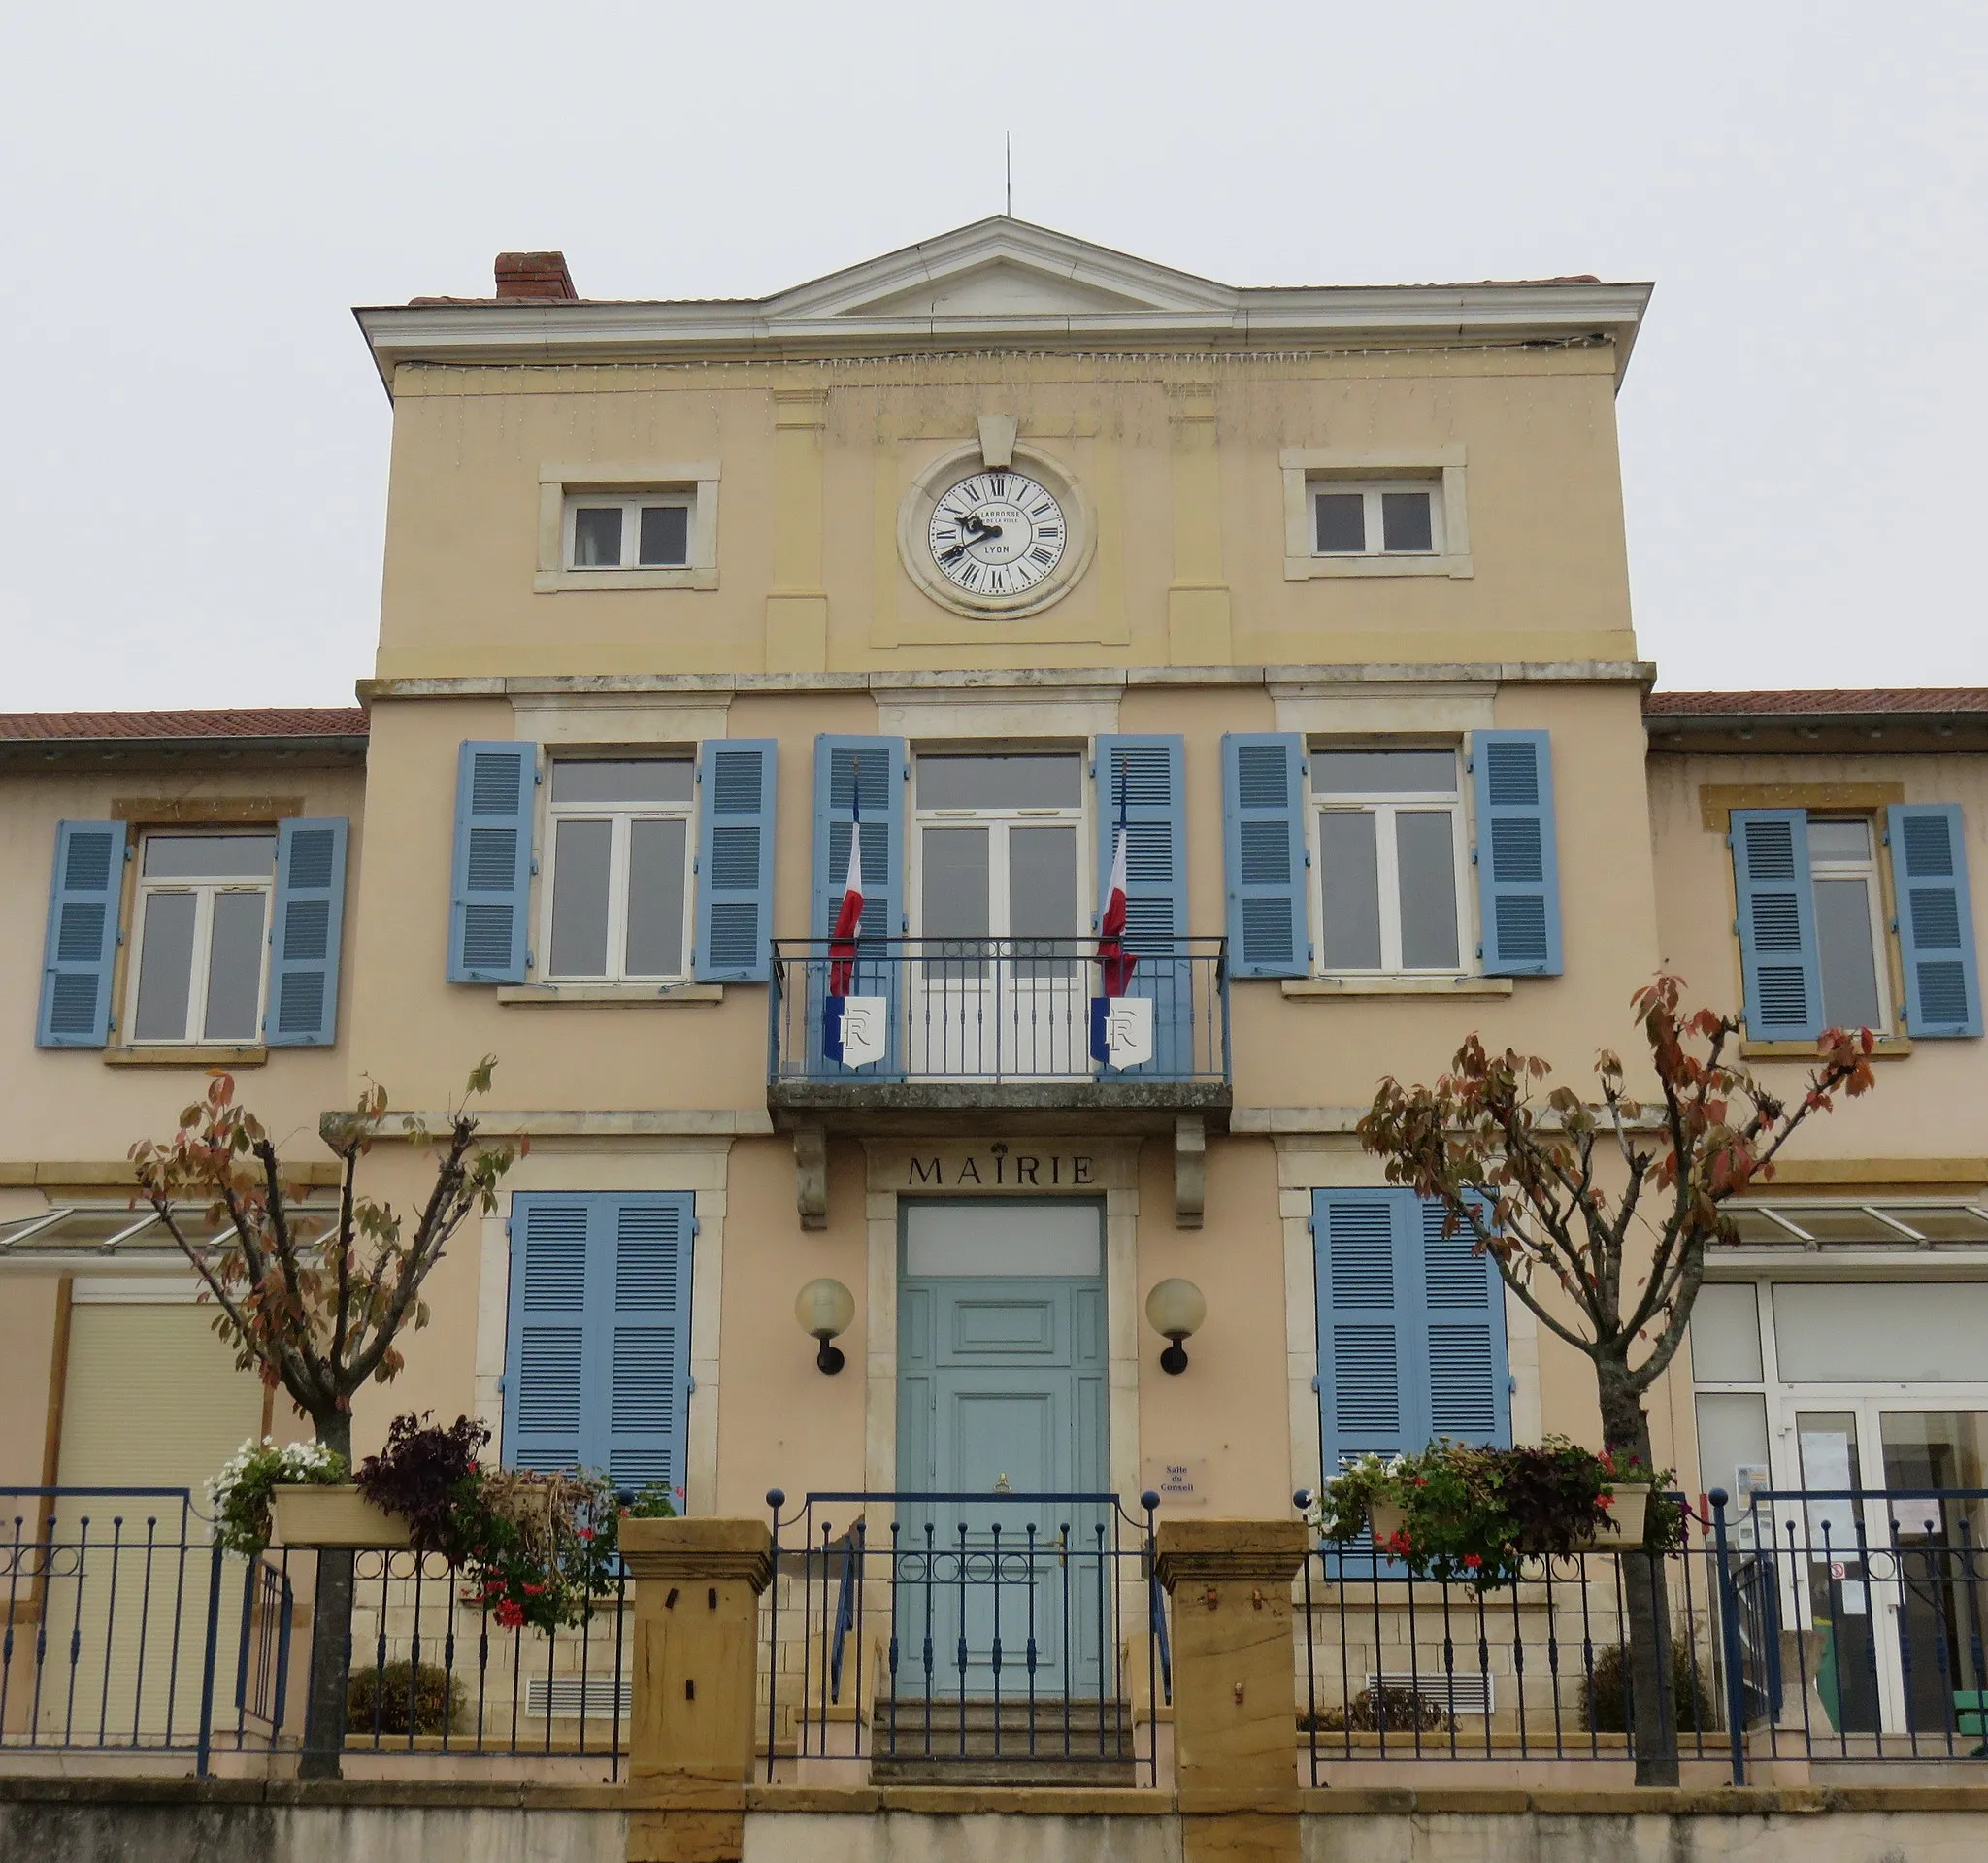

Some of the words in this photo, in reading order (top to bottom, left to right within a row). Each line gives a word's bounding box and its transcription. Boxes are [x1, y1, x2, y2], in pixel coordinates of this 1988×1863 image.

[962, 483, 980, 504] XI
[989, 479, 1005, 496] XII
[1015, 484, 1029, 502] I
[1031, 502, 1051, 517] II
[936, 528, 957, 541] IX
[1038, 527, 1058, 538] III
[1029, 546, 1054, 566] IIII
[961, 562, 980, 584] VII
[991, 570, 1004, 588] VI
[1017, 565, 1031, 582] V
[909, 1156, 1095, 1186] MAIRIE
[1166, 1465, 1188, 1474] Salle
